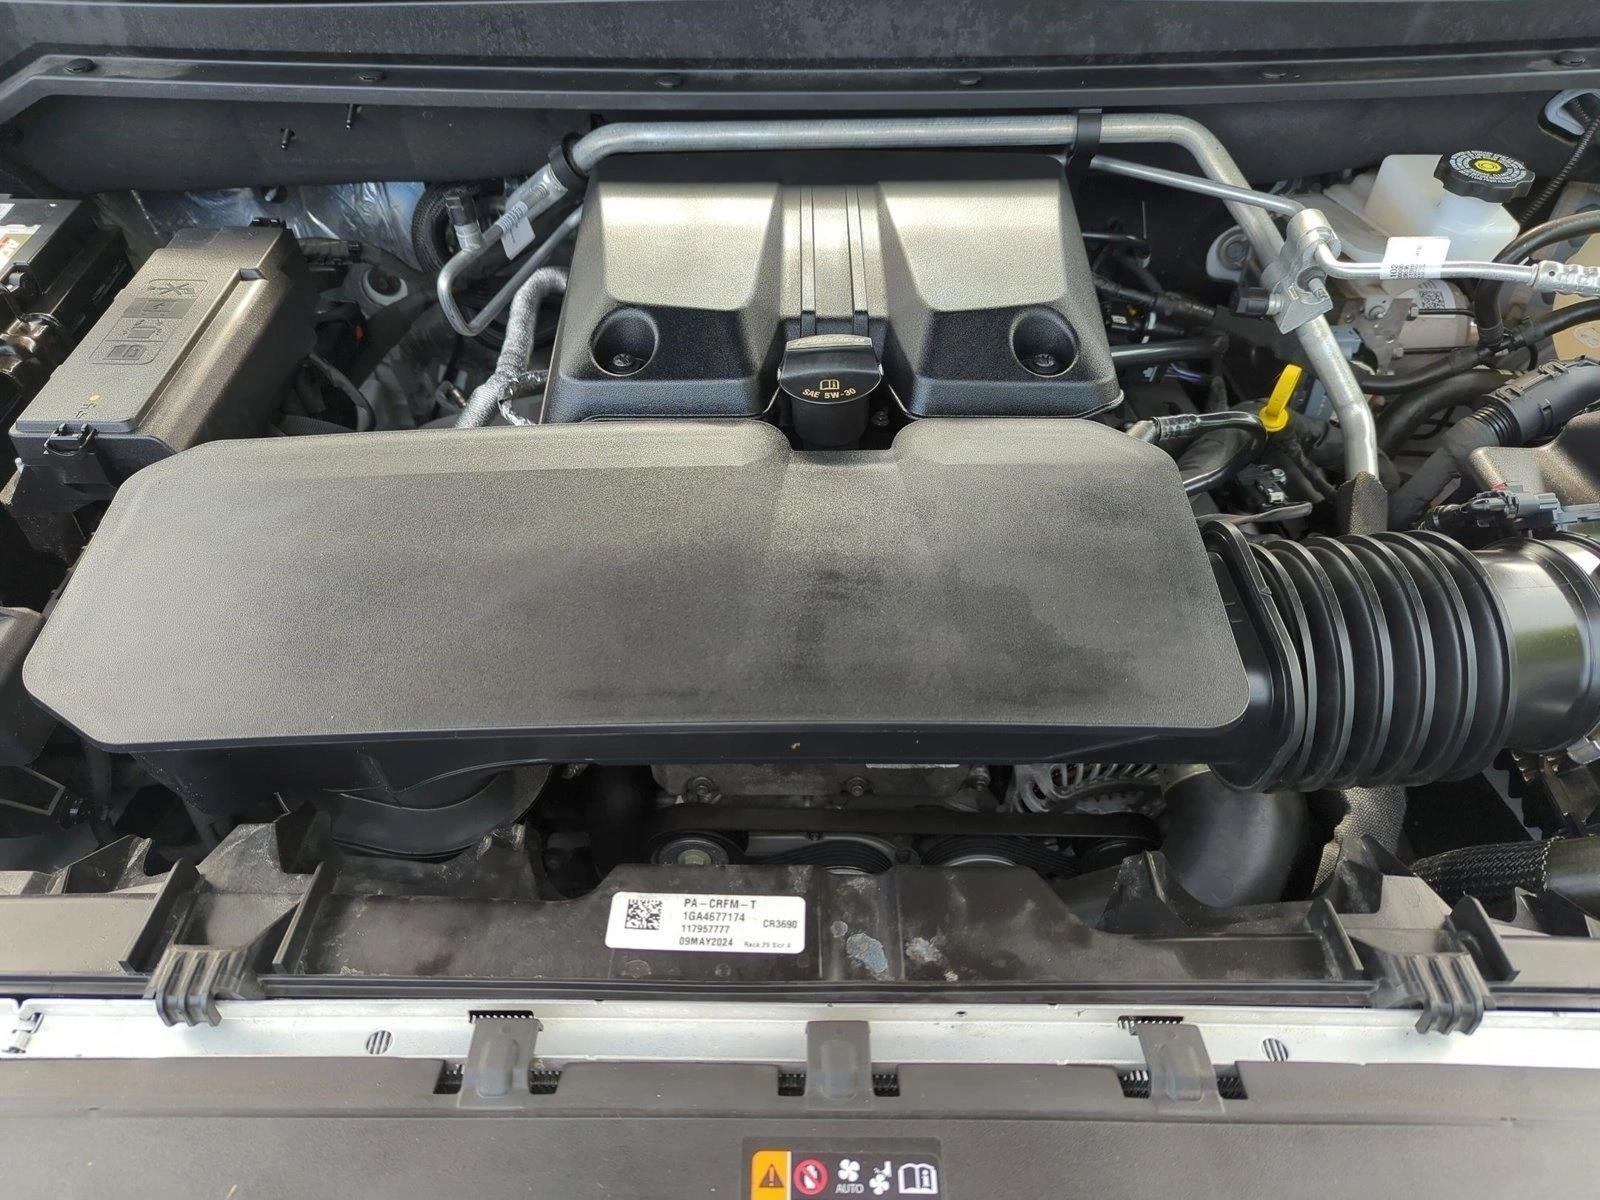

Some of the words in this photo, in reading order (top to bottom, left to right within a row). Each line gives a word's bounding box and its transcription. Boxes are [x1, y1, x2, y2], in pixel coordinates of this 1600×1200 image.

[802, 388, 820, 398] SAE
[824, 387, 856, 399] 5W-30
[684, 911, 745, 922] 1GA4677174
[681, 924, 730, 934] 117957777
[679, 936, 733, 947] 09MAY2024
[835, 1183, 864, 1194] AUTO
